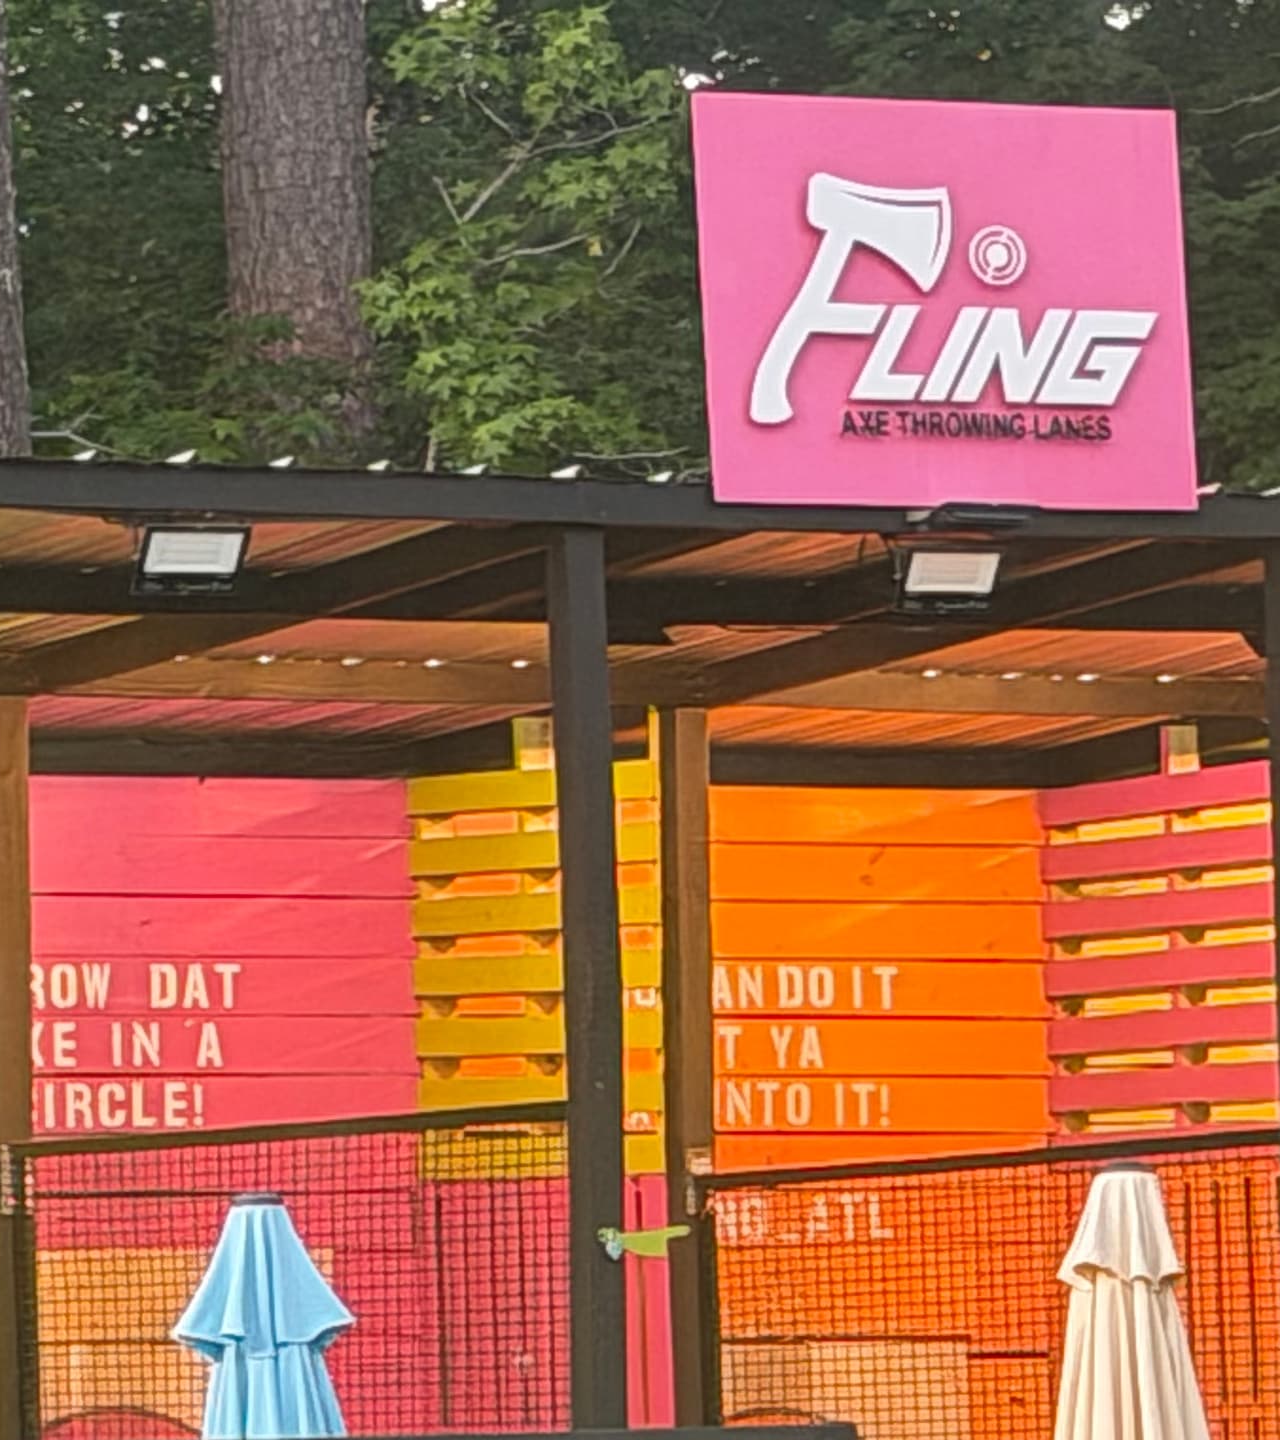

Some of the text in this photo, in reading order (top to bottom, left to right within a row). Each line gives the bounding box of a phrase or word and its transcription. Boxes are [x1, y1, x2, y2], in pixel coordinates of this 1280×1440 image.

[750, 172, 1158, 424] FLING
[841, 410, 1113, 441] AXE THROWING LANES
[150, 963, 241, 1009] DAT
[778, 965, 834, 1009] DO
[852, 966, 898, 1010] IT
[111, 1021, 160, 1067] IN
[197, 1022, 224, 1067] A
[770, 1026, 824, 1069] YA
[835, 1083, 891, 1127] IT!
